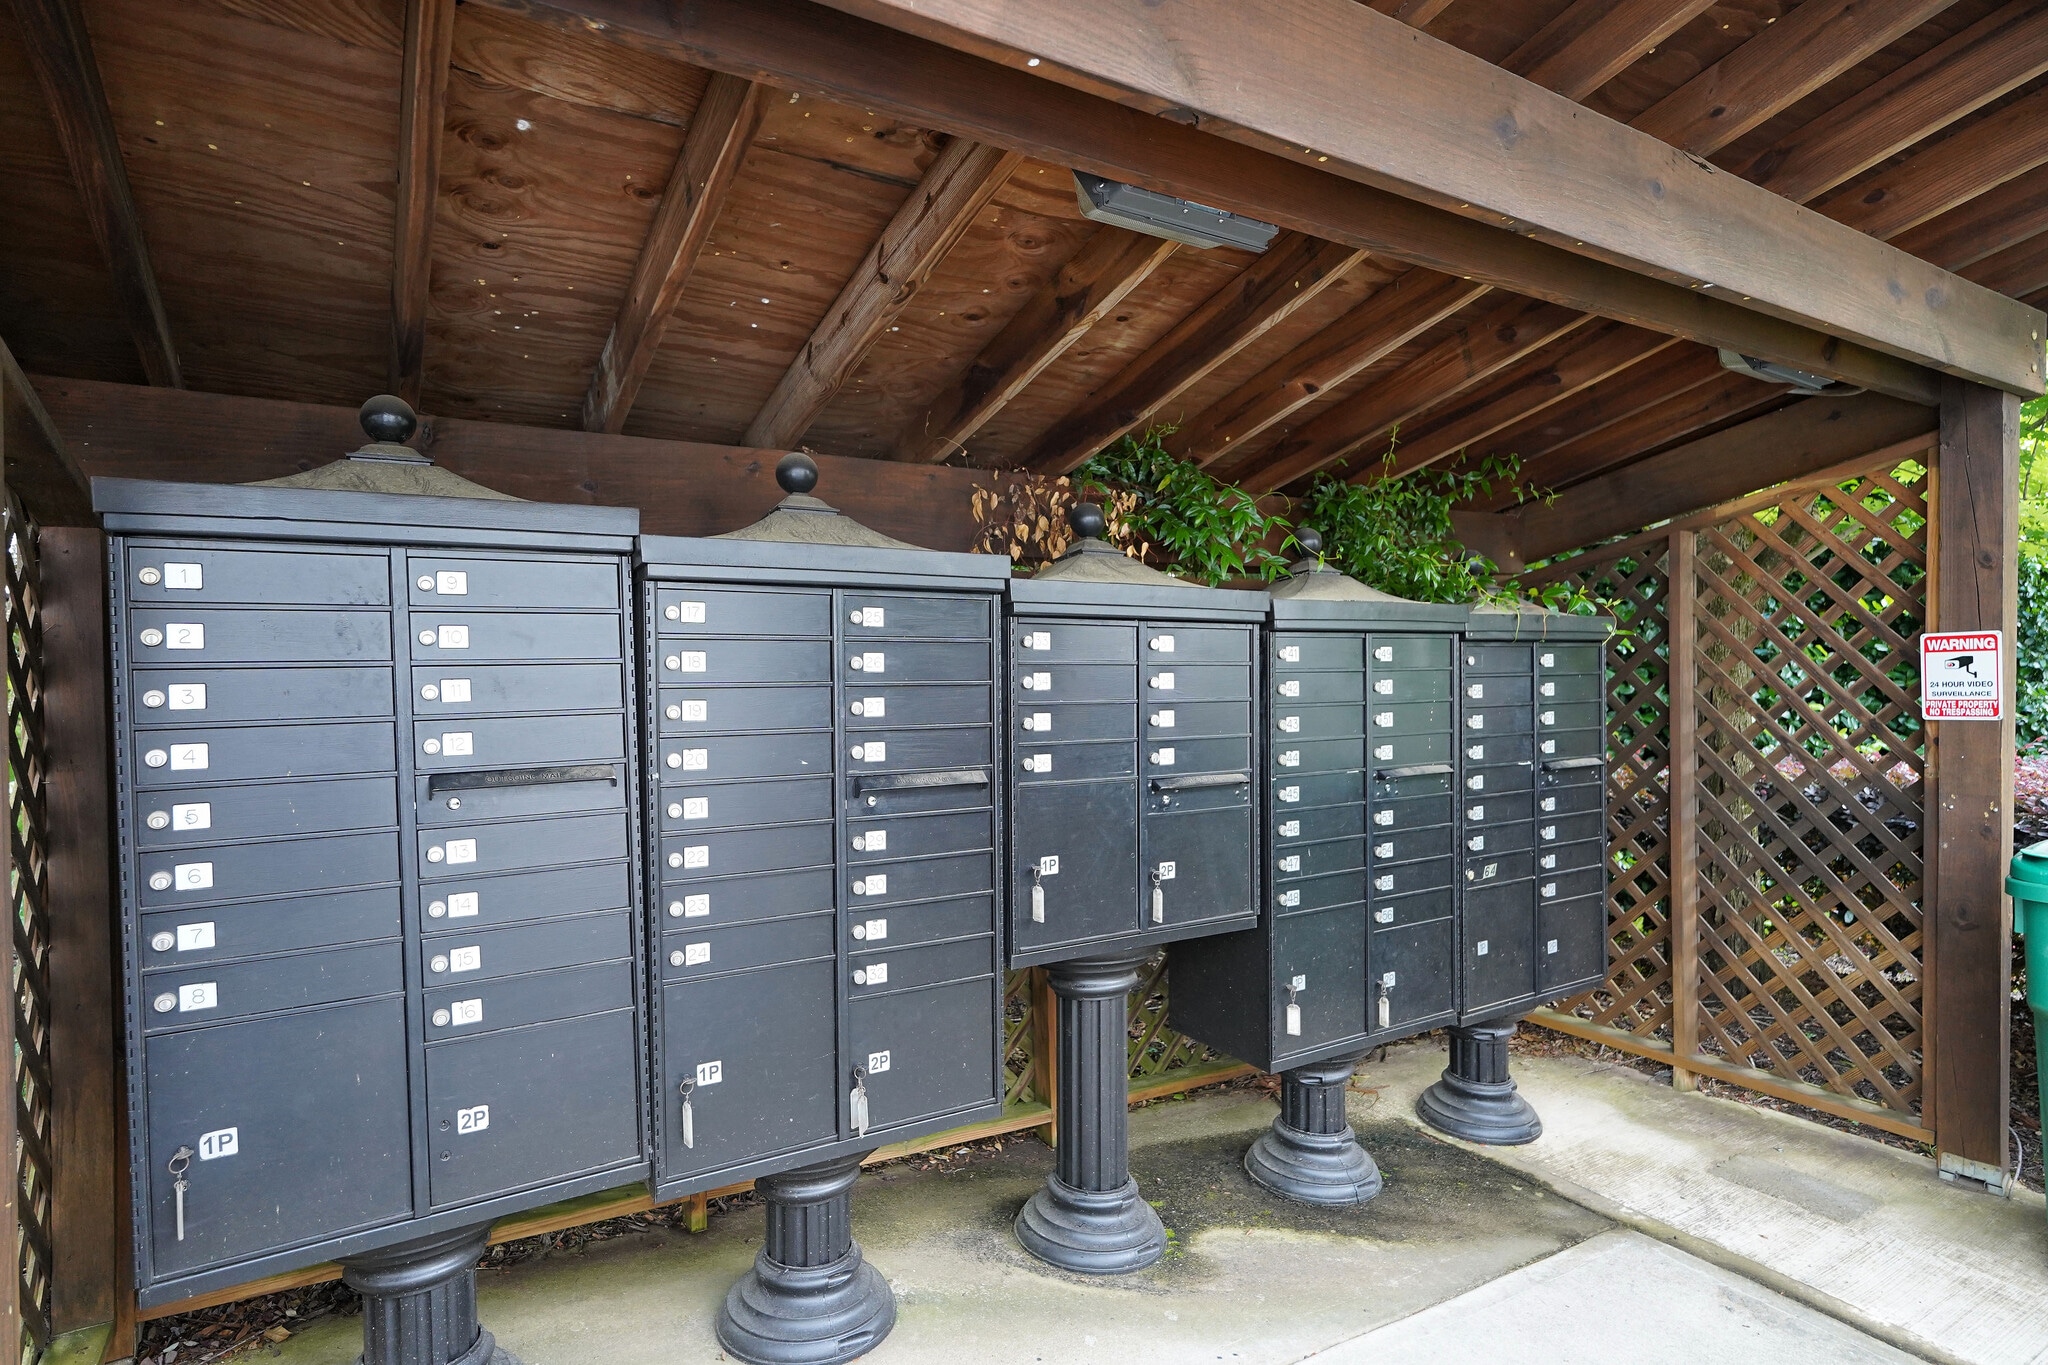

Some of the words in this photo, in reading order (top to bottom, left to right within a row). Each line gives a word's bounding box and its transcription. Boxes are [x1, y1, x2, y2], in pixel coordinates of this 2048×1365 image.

[447, 576, 457, 590] 9
[687, 606, 700, 618] 17
[865, 611, 881, 623] 25
[179, 628, 191, 644] 2
[446, 630, 462, 644] 10
[1926, 637, 1995, 651] WARNING
[1288, 649, 1297, 659] 41
[1381, 649, 1391, 659] 49
[688, 656, 701, 668] 18
[450, 684, 461, 697] 11
[1287, 683, 1297, 694] 42
[1381, 682, 1391, 692] 50
[182, 689, 194, 704] 3
[688, 704, 701, 717] 19
[1926, 700, 1956, 708] PRIVATE
[1958, 700, 1998, 708] PROPERTY
[1930, 708, 1940, 716] NO
[1942, 708, 1994, 716] TRESPASSING
[1287, 719, 1298, 729] 43
[450, 737, 465, 751] 12
[183, 749, 196, 763] 4
[1287, 753, 1298, 763] 44
[1382, 747, 1391, 757] 52
[686, 753, 705, 766] 20
[1287, 788, 1298, 799] 45
[689, 802, 703, 814] 21
[185, 809, 198, 825] 5
[1383, 812, 1392, 823] 53
[1287, 823, 1298, 834] 46
[868, 835, 883, 846] 29
[454, 844, 470, 858] 13
[687, 850, 705, 864] 22
[1382, 845, 1391, 856] 54
[1042, 859, 1056, 872] 1P
[1288, 858, 1298, 868] 47
[188, 869, 201, 883] 6
[1161, 865, 1174, 876] 2P
[1485, 865, 1496, 876] 64
[868, 879, 884, 891] 30
[1382, 877, 1392, 888] 55
[455, 898, 471, 911] 14
[1288, 893, 1298, 903] 48
[688, 899, 707, 912] 23
[1382, 910, 1392, 920] 56
[190, 928, 202, 943] 7
[871, 923, 883, 935] 31
[458, 952, 473, 967] 15
[689, 947, 707, 961] 24
[869, 967, 884, 980] 32
[192, 989, 205, 1004] 8
[459, 1004, 475, 1019] 16
[871, 1054, 888, 1070] 2P
[699, 1064, 719, 1082] 1P
[461, 1110, 486, 1130] 2P
[203, 1133, 233, 1155] 1P
